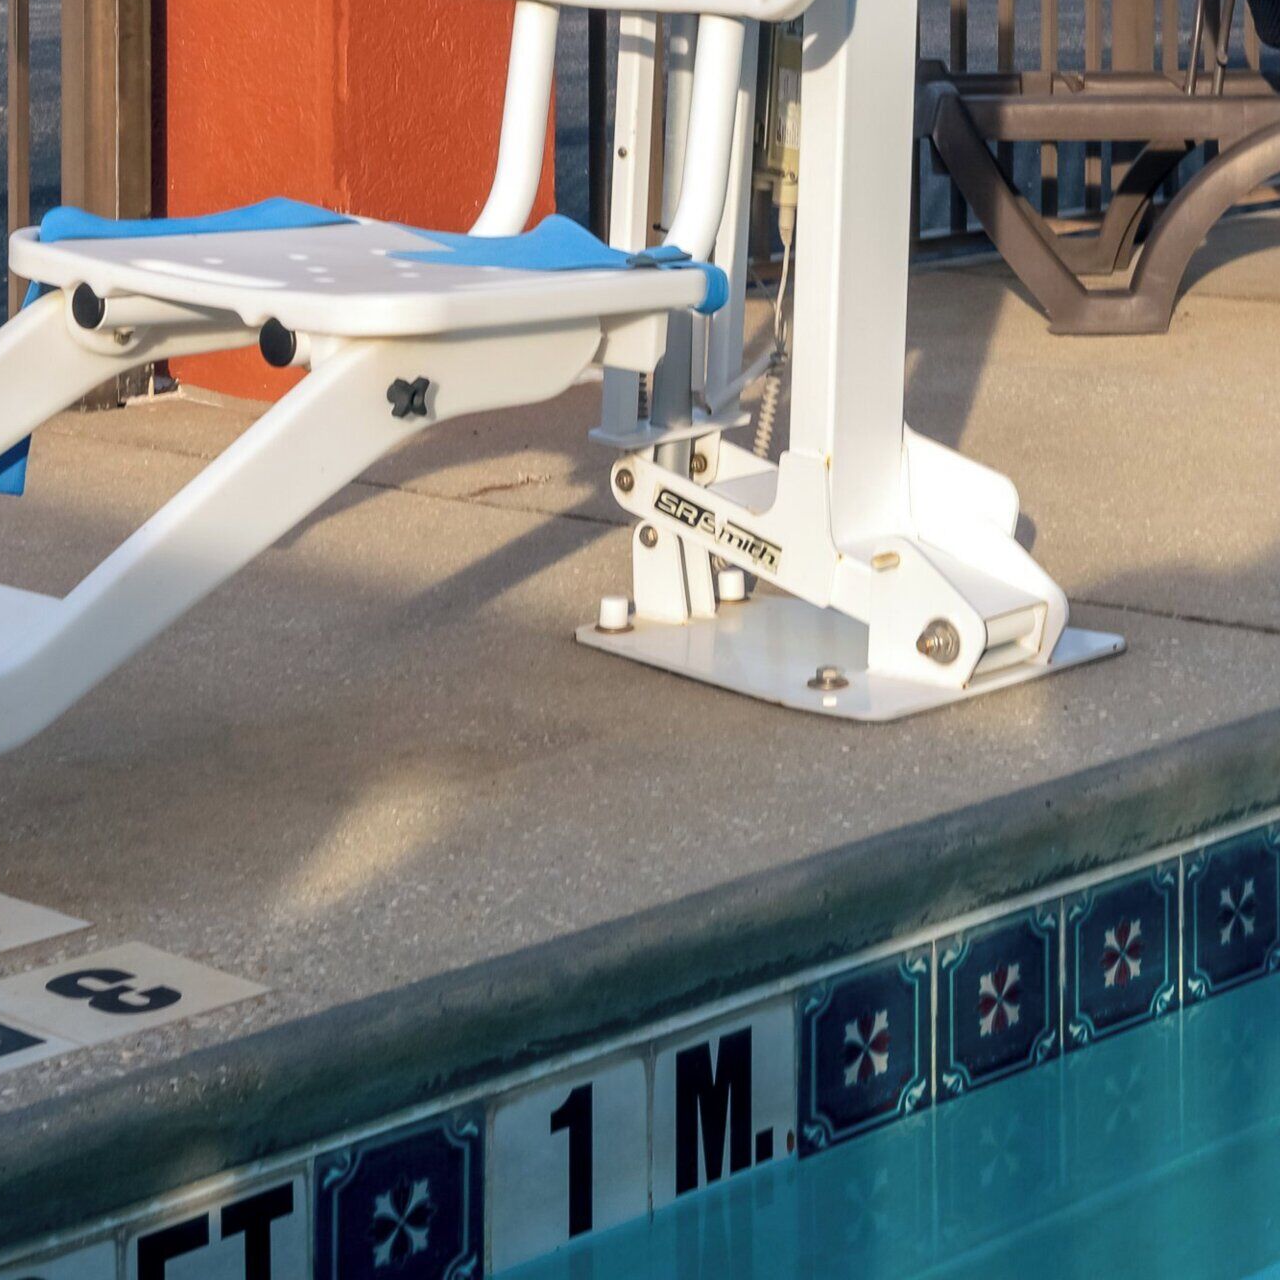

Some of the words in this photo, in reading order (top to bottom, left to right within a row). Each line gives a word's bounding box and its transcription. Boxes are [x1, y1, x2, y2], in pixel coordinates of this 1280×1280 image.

[44, 967, 183, 1015] 3
[550, 1083, 594, 1239] 1
[674, 1026, 776, 1198] M.
